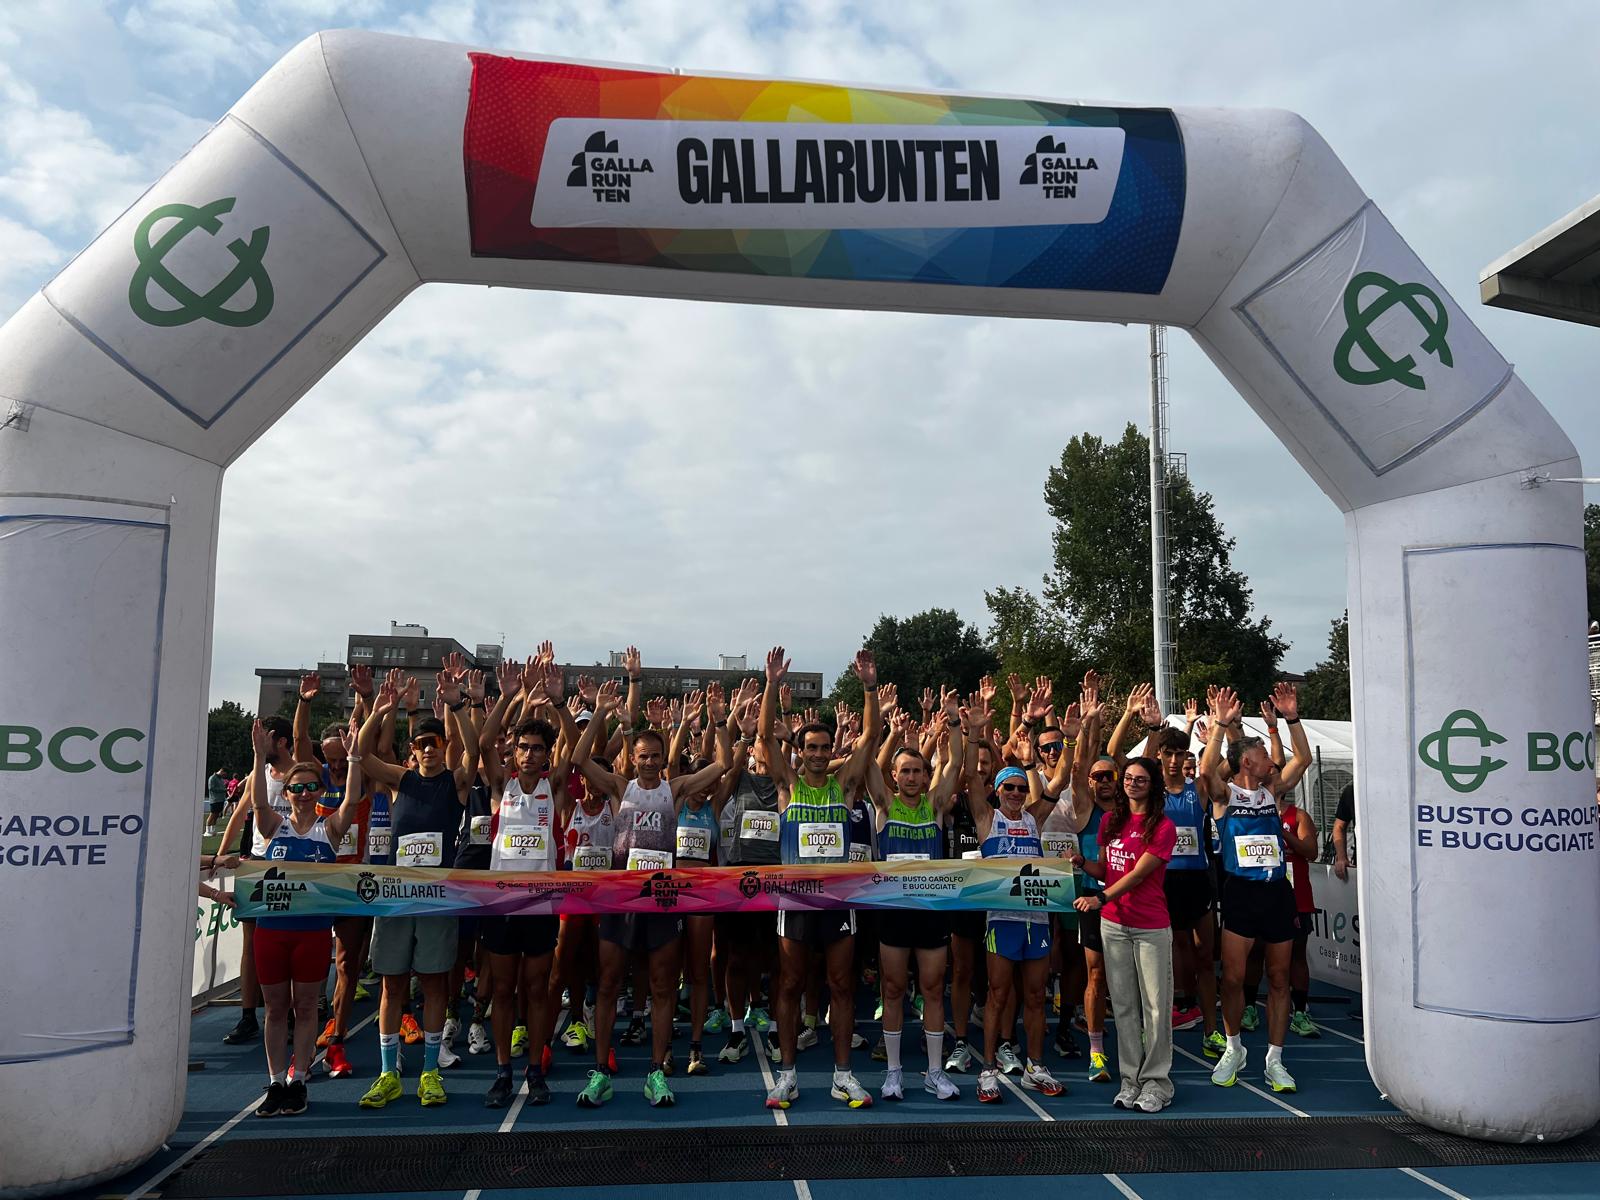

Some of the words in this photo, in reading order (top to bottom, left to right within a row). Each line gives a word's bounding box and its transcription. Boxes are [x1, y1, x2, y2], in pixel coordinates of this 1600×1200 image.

[591, 158, 654, 172] GALLA
[1042, 158, 1098, 170] GALLA
[677, 138, 1000, 204] GALLARUNTEN
[592, 173, 631, 187] RUN
[1042, 171, 1078, 184] RUN
[593, 189, 630, 203] TEN
[1043, 186, 1076, 198] TEN
[0, 725, 146, 774] BCC
[633, 811, 662, 827] DKR
[787, 807, 830, 823] ATLETICA
[1417, 805, 1513, 826] BUSTO
[1521, 807, 1598, 827] GAROLF
[0, 815, 143, 837] AROLFO
[750, 819, 772, 830] 10118
[888, 825, 924, 840] ATLETICA
[369, 836, 390, 846] 0190
[511, 835, 541, 847] 10227
[678, 836, 704, 848] 10002
[807, 833, 836, 845] 10073
[1175, 836, 1193, 845] 231
[1418, 830, 1432, 847] E
[1441, 830, 1594, 852] BUGUGGIATE
[0, 845, 107, 866] GIATE
[405, 843, 434, 856] 10079
[1111, 849, 1135, 860] GALLA
[1245, 845, 1273, 856] 10072
[580, 856, 606, 867] 10003
[1111, 856, 1125, 865] RUN
[1111, 863, 1124, 872] TEN
[266, 883, 307, 891] GALLA
[764, 880, 825, 894] GALLARATE
[1024, 879, 1061, 888] GALLA
[266, 893, 292, 901] RUN
[382, 885, 446, 898] GALLARATE
[1024, 888, 1048, 897] RUN
[266, 903, 290, 911] TEN
[656, 898, 678, 907] TEN
[1024, 898, 1047, 907] TEN
[1320, 946, 1348, 962] Cassano
[1350, 953, 1361, 967] Ma
